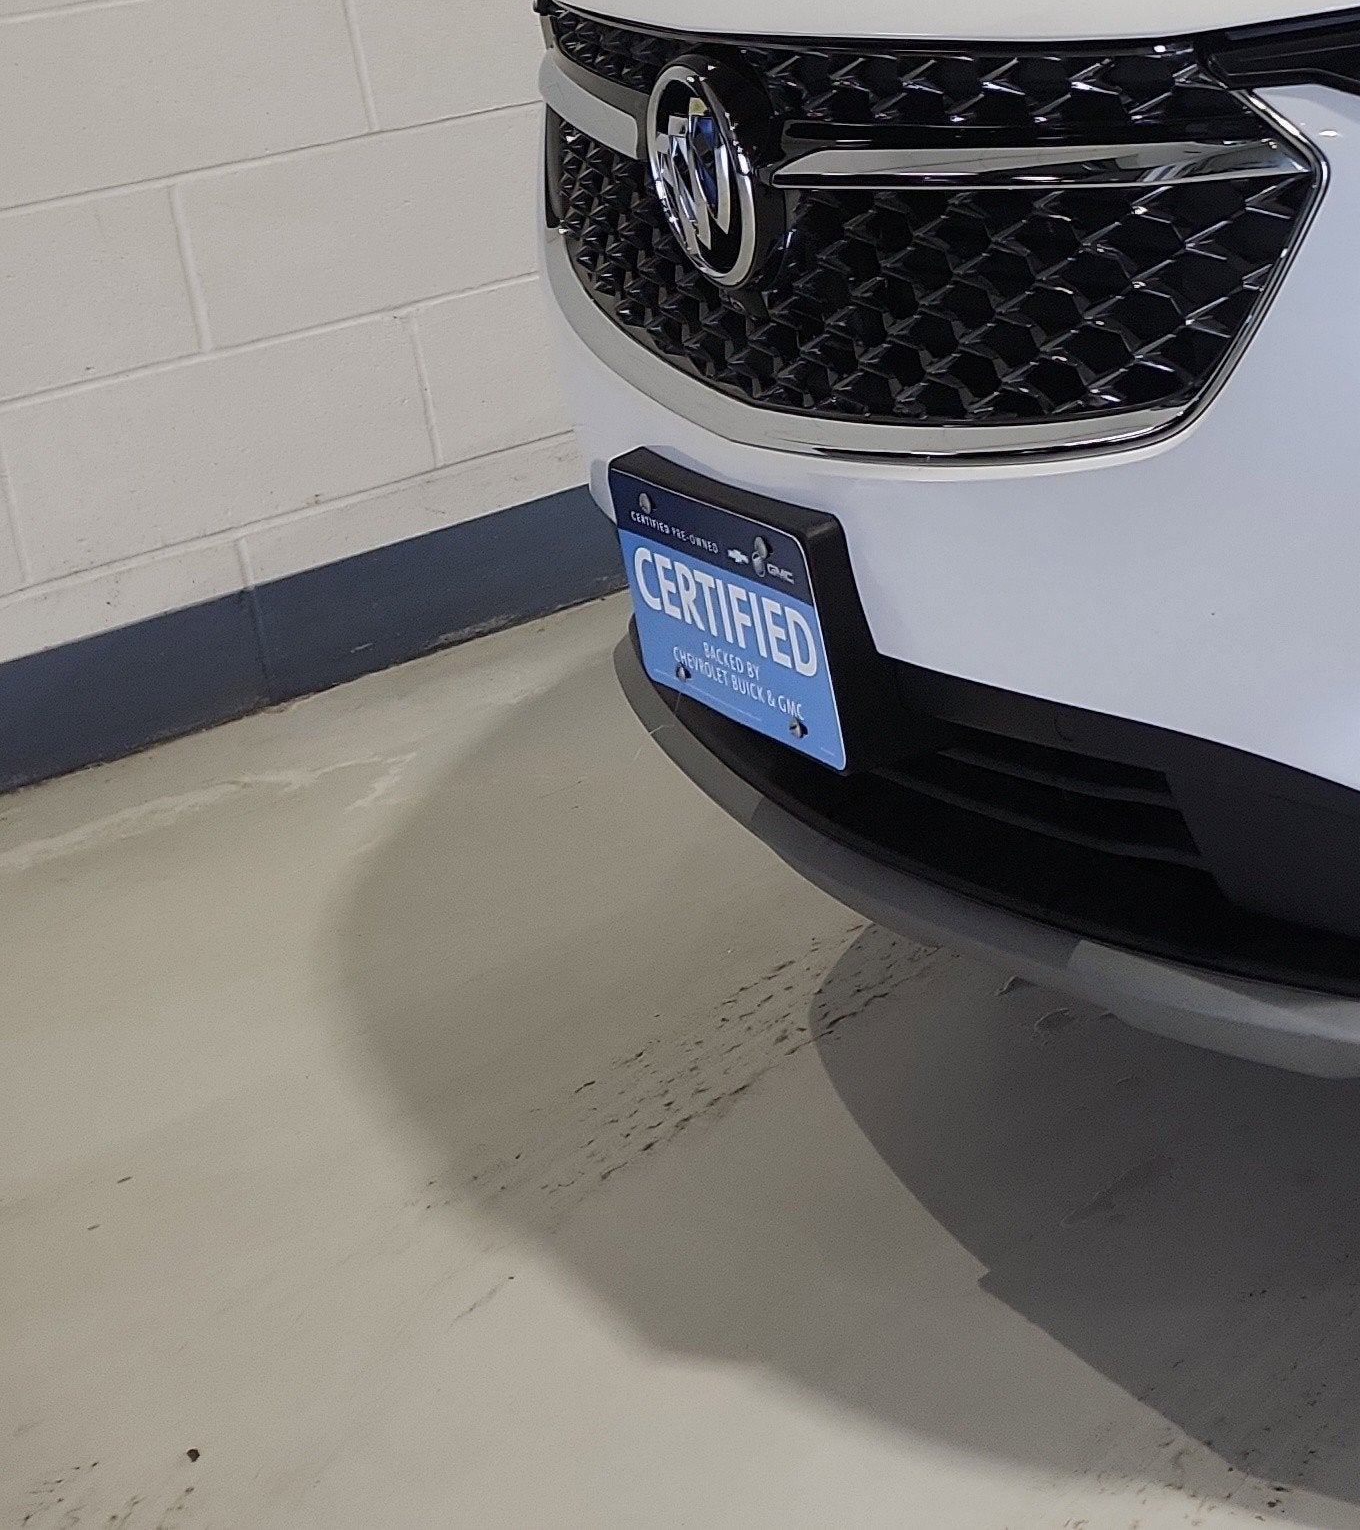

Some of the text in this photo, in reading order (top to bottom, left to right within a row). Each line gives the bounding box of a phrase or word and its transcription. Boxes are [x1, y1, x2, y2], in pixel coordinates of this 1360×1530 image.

[630, 511, 719, 554] CERTIFIED PRE-OWNED
[767, 563, 795, 584] GMC
[634, 547, 817, 677] CERTIFIED
[703, 642, 760, 681] BACKED BY
[673, 646, 729, 687] CHEVROLET
[732, 676, 765, 706] BUICK
[767, 689, 776, 708] &
[778, 695, 805, 721] GMC
